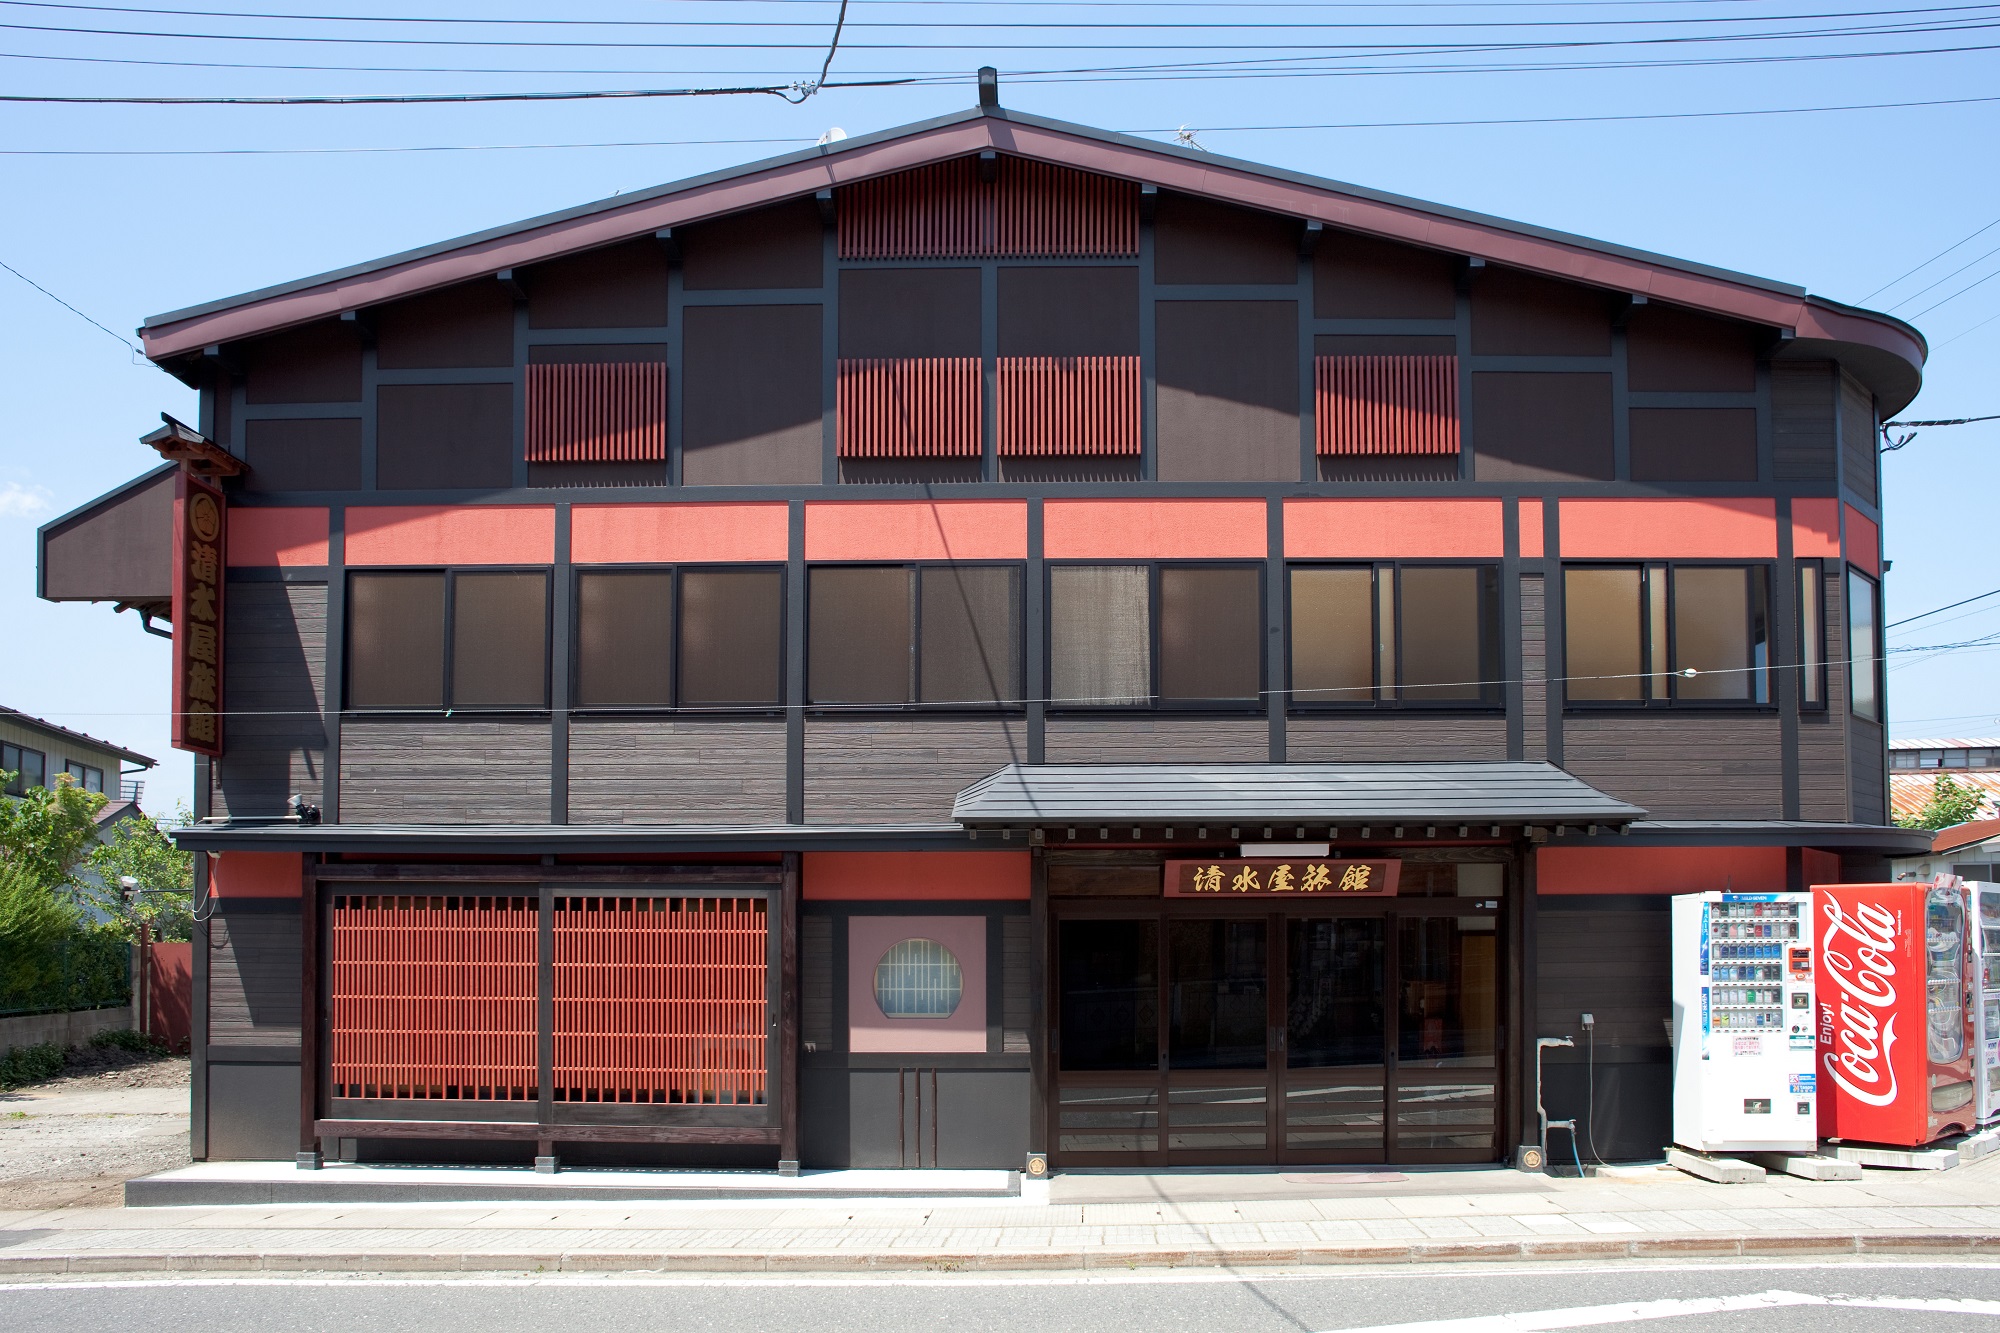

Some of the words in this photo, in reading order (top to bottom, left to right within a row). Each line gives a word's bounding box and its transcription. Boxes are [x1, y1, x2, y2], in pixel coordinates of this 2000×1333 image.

[188, 540, 218, 744] 清水屋旅館
[1193, 864, 1372, 893] 清水屋旅館
[1820, 1002, 1835, 1045] Enjoy!
[1823, 890, 1898, 1107] Coca-Cola
